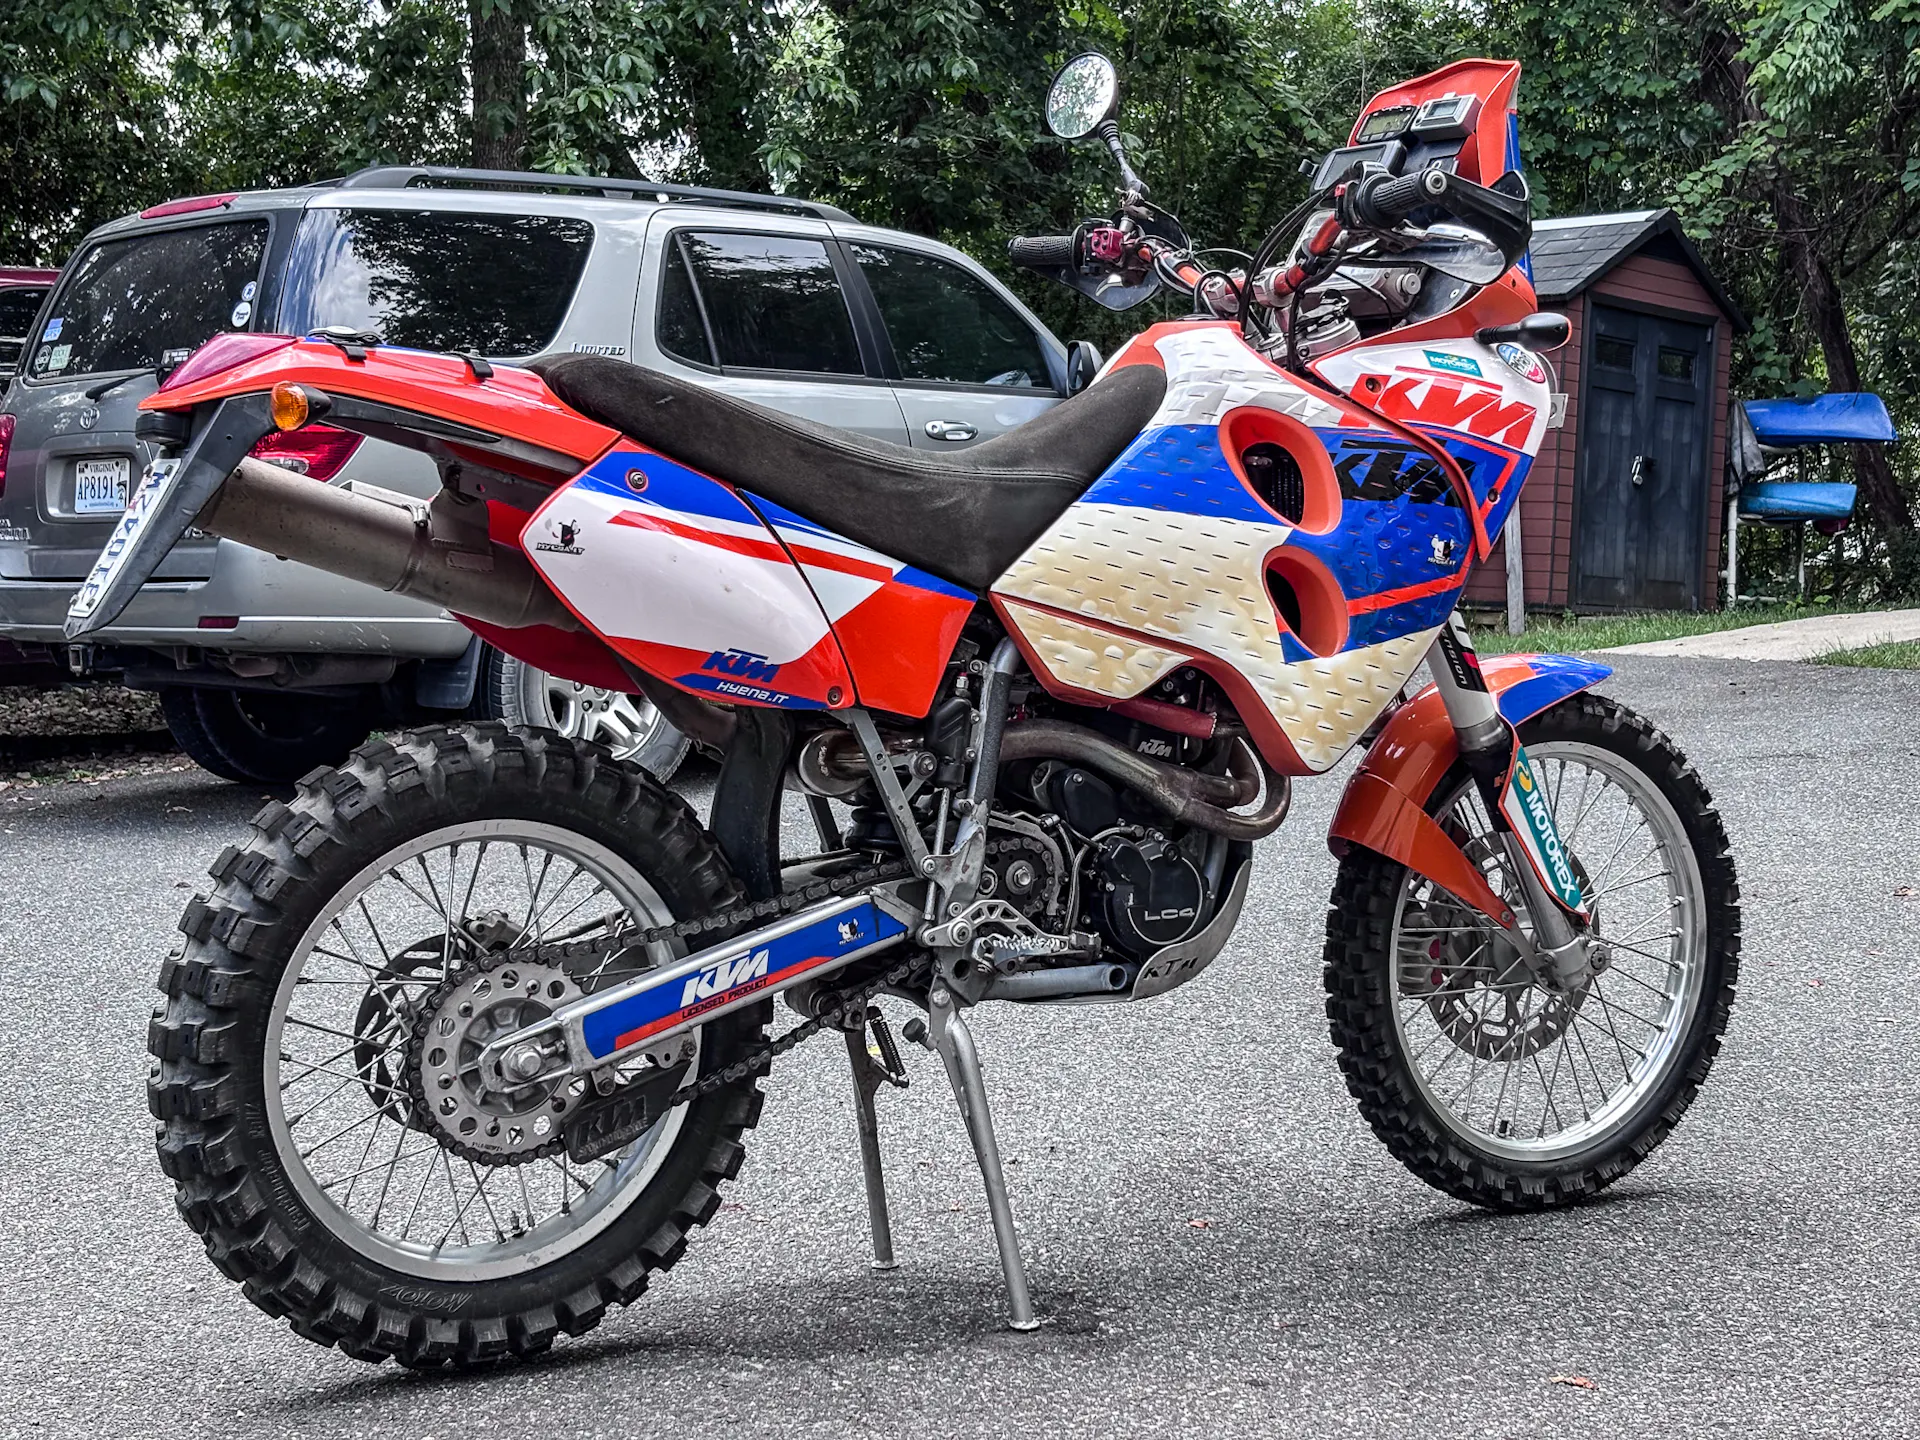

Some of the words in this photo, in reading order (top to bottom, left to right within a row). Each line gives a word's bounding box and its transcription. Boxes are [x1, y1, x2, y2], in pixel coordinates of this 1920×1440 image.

[570, 342, 626, 356] LIMITED
[1338, 366, 1537, 450] KTM
[89, 463, 115, 473] VIRGINIA
[77, 475, 114, 500] AP8191
[701, 648, 780, 683] KTM
[1137, 738, 1172, 757] KTM
[1526, 792, 1577, 900] MOTOREX
[1144, 908, 1195, 921] LC4
[680, 949, 770, 1008] KTM
[1142, 957, 1199, 980] KTM
[682, 996, 725, 1019] LICENSED
[728, 977, 768, 1000] PRODUCT
